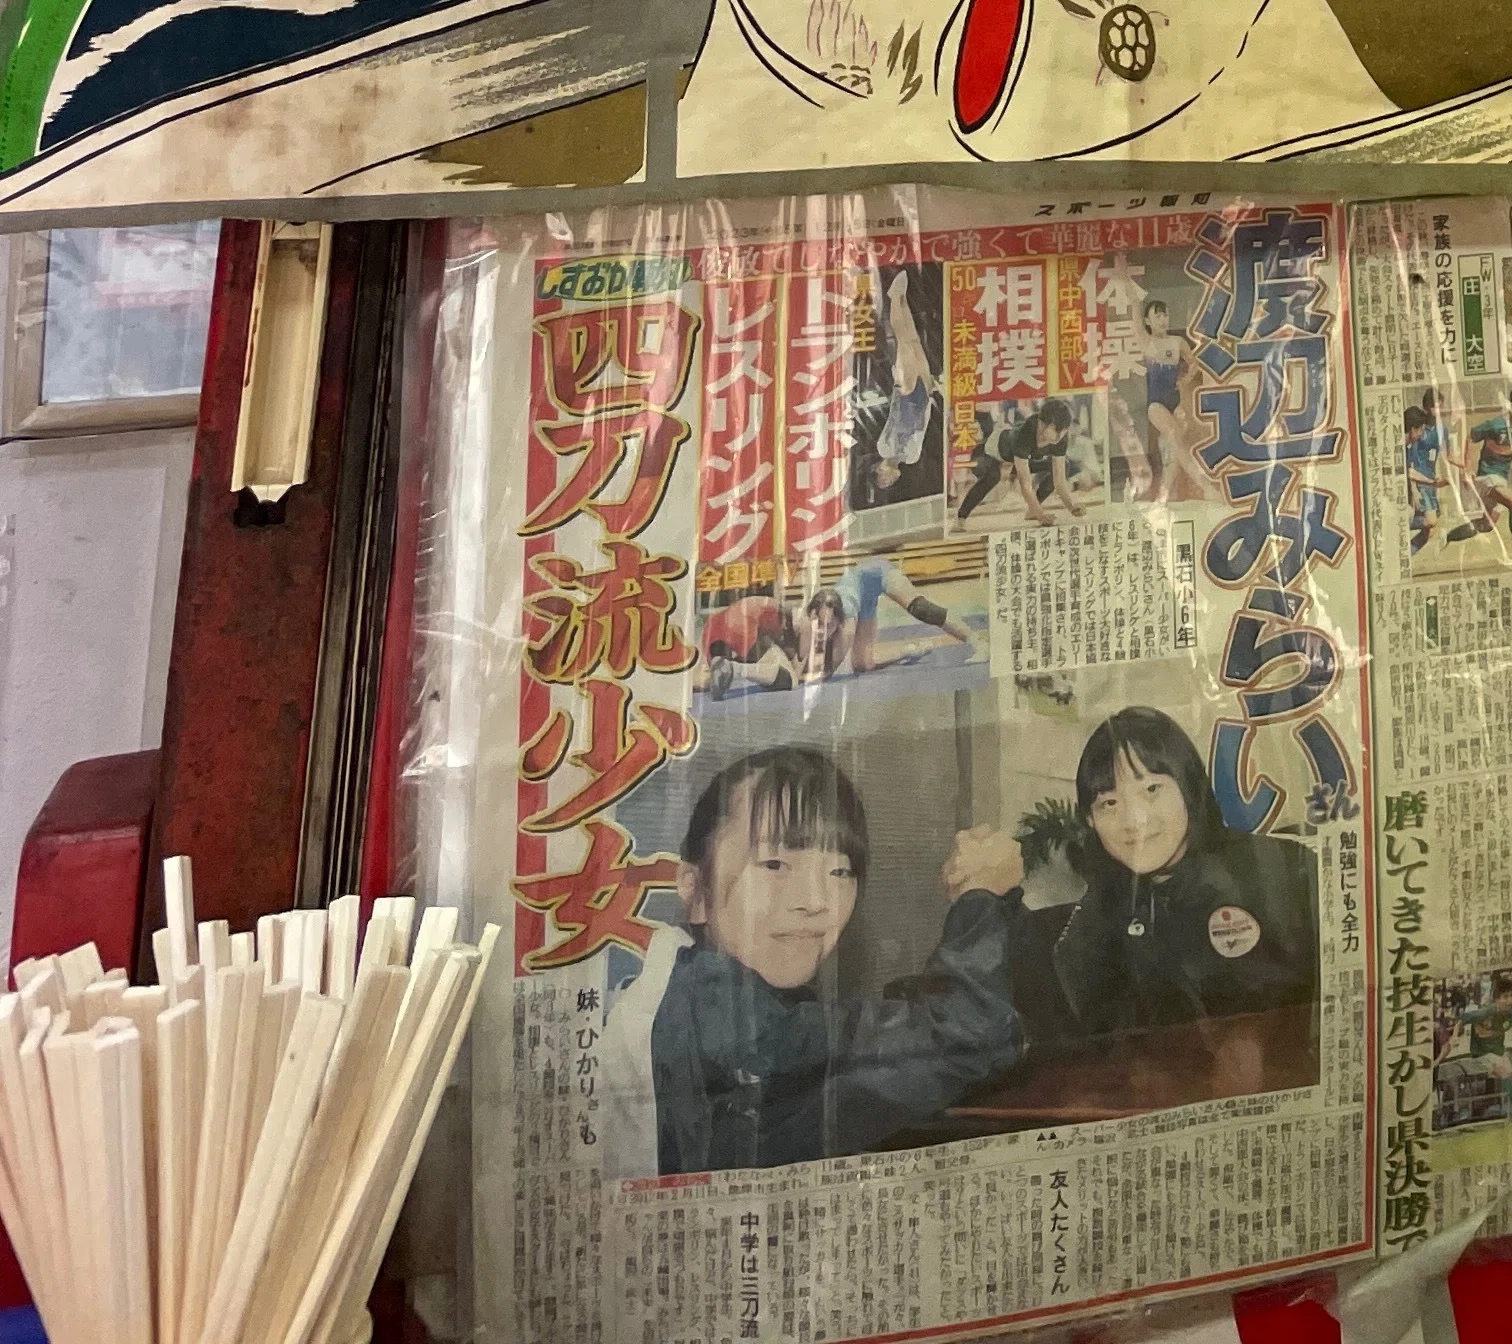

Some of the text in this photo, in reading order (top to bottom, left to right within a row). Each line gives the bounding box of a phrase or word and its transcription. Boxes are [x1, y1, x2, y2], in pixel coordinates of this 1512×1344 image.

[972, 263, 1046, 395] 相撲
[1078, 252, 1149, 384] 体操
[704, 286, 775, 564] レスリング
[786, 277, 858, 552] トランポリン
[510, 300, 701, 975] 四刀流少女
[1340, 830, 1359, 953] 勉強にも全力
[1049, 1167, 1071, 1296] 友人たくさん
